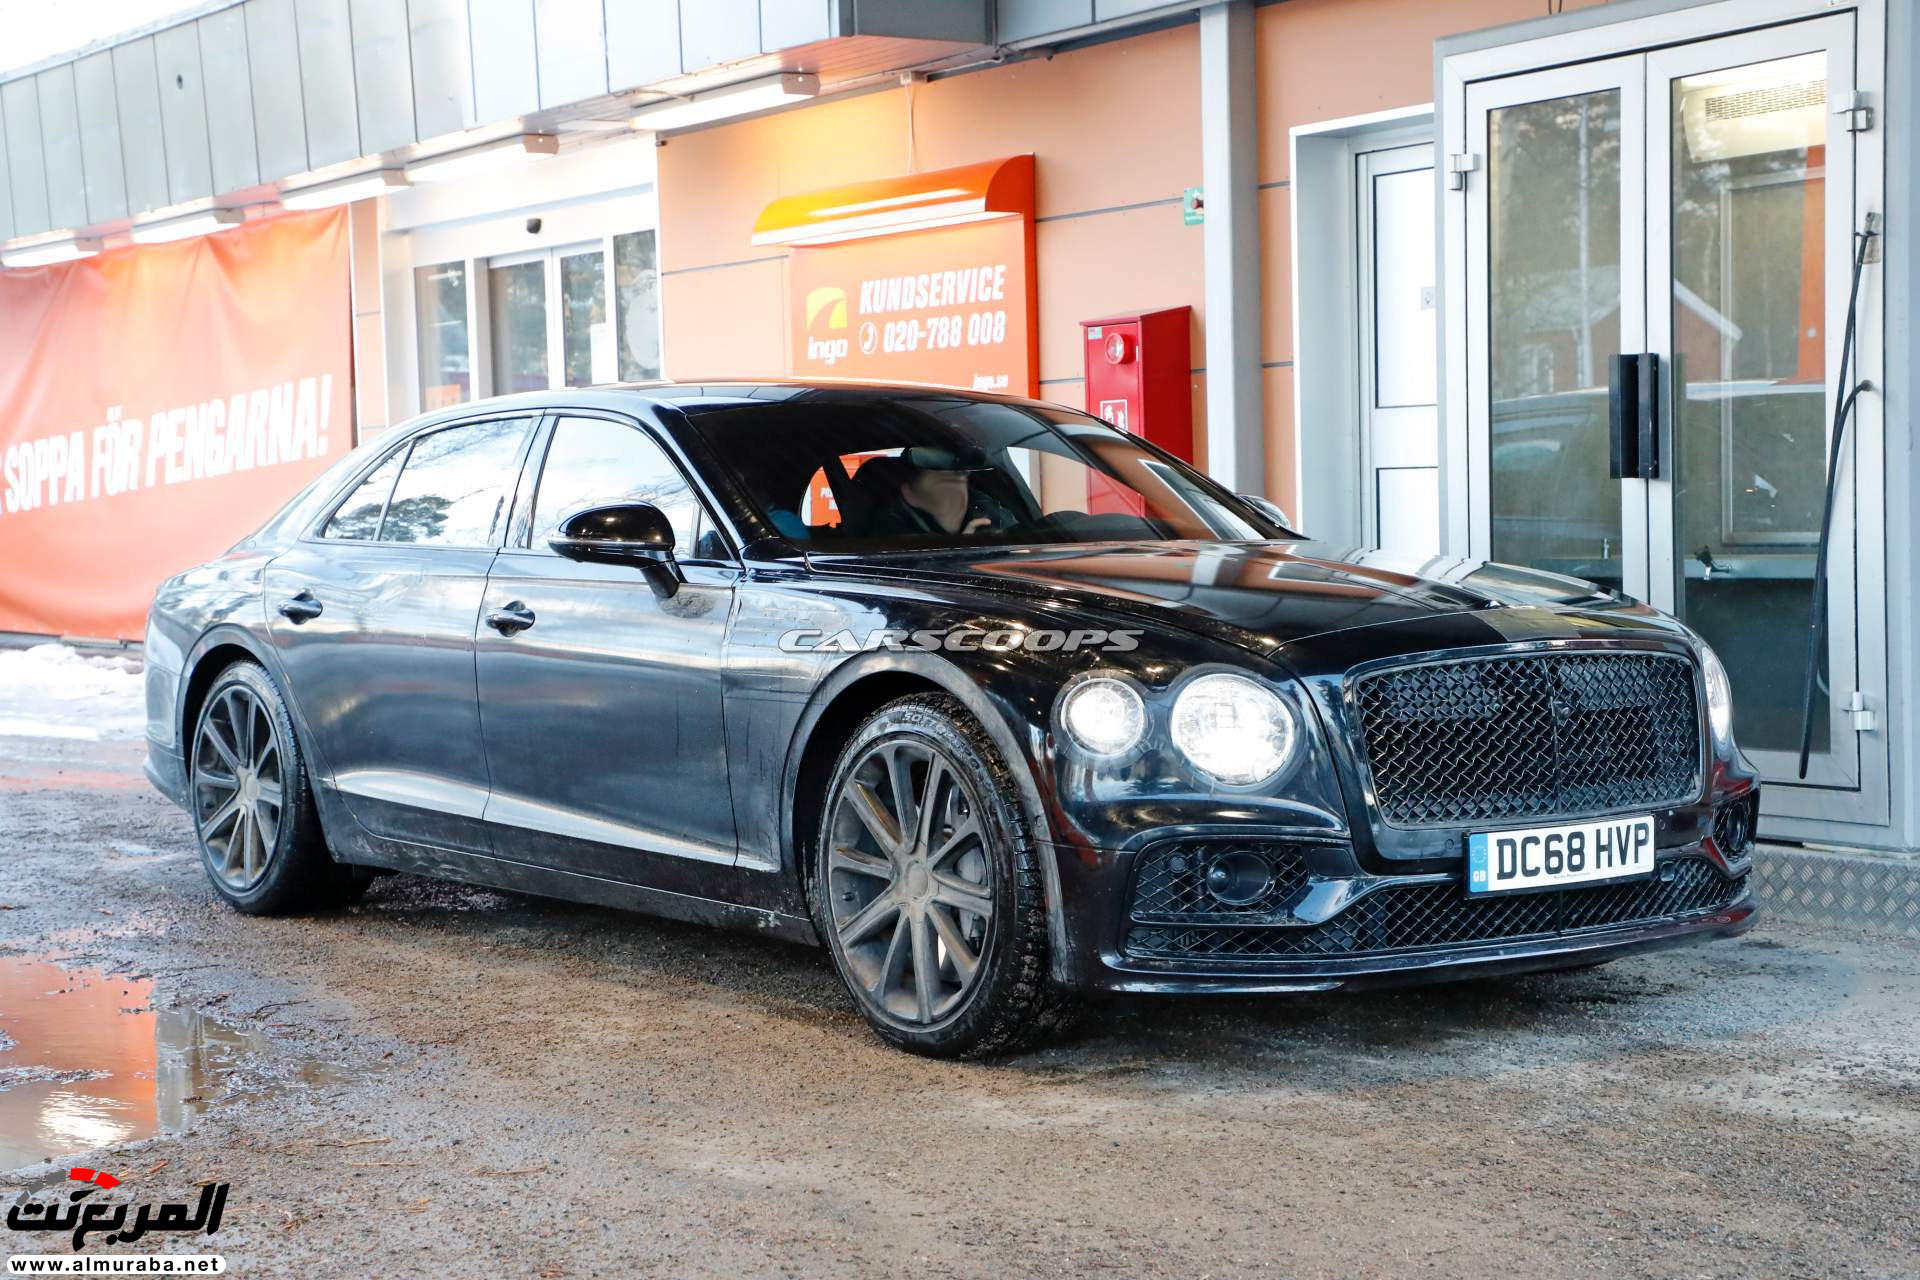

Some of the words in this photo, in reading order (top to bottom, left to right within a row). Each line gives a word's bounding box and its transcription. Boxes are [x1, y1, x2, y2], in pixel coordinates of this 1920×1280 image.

[859, 264, 1007, 314] KUNDSERVICE
[807, 336, 848, 365] ingo
[883, 314, 962, 353] 020-788
[967, 310, 1007, 346] 008
[4, 431, 85, 513] SOPPA
[91, 404, 143, 499] FÖR
[145, 374, 333, 488] PENGARNA!
[1496, 830, 1586, 881] DC68
[1595, 822, 1650, 869] HVP
[1472, 869, 1487, 883] GB
